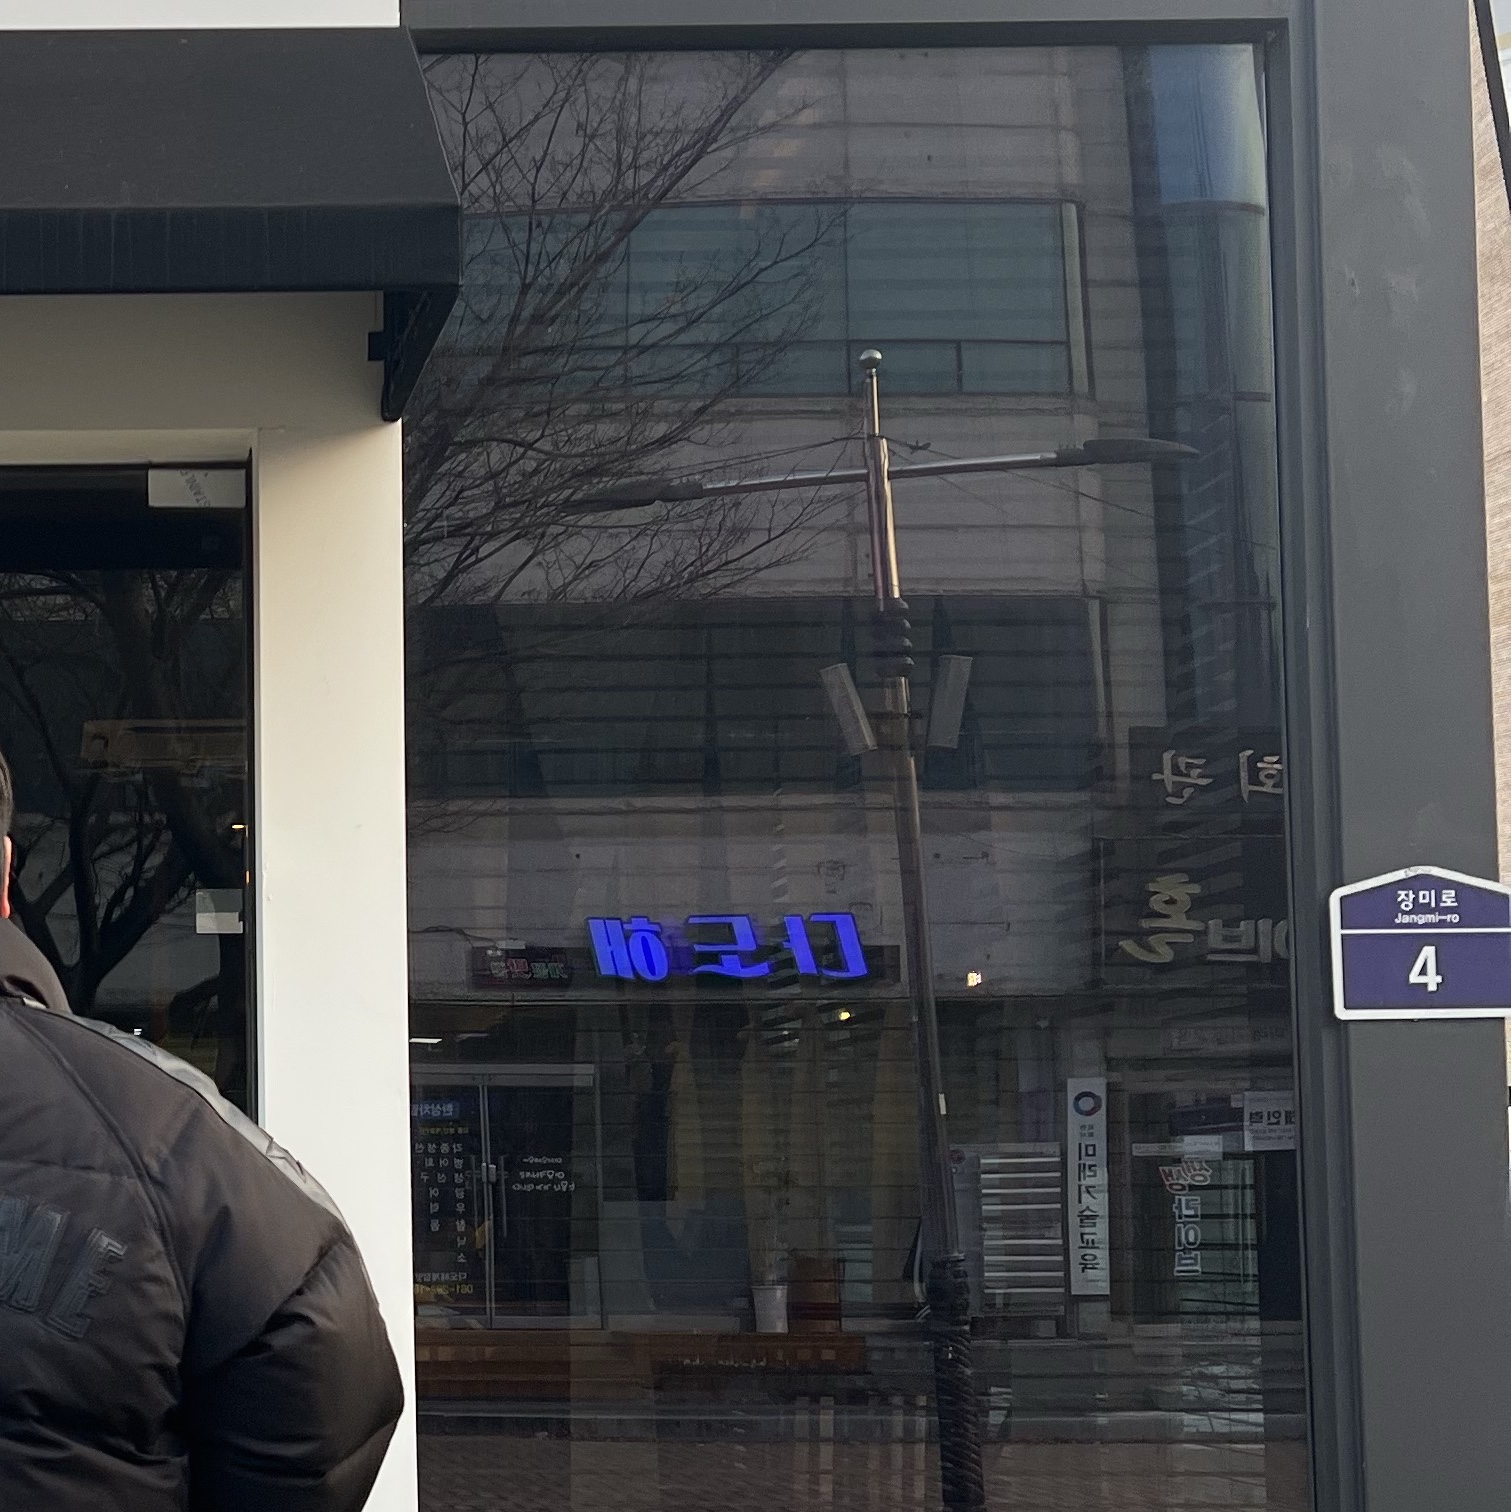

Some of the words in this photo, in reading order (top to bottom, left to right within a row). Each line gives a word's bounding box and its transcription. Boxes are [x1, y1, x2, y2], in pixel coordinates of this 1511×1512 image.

[1396, 889, 1459, 911] 장미로
[1394, 911, 1460, 925] Jangmi-ro
[1408, 945, 1443, 992] 4
